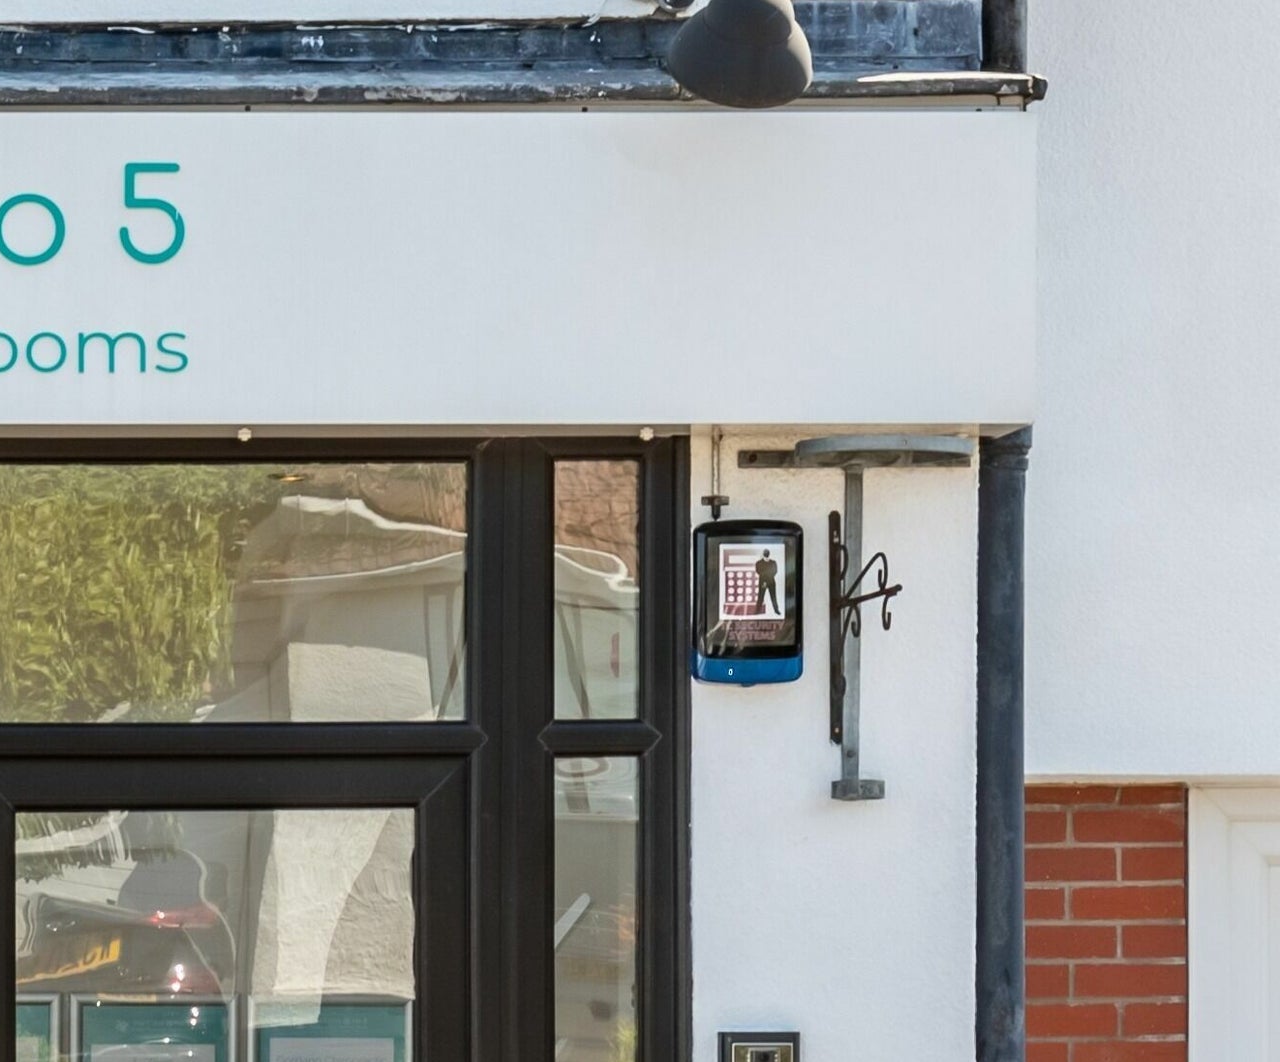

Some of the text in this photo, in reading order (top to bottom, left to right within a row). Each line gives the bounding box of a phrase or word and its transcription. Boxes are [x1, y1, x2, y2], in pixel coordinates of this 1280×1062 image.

[119, 162, 185, 264] 5
[735, 620, 785, 631] SECURITY
[728, 631, 776, 640] SYSTEMS
